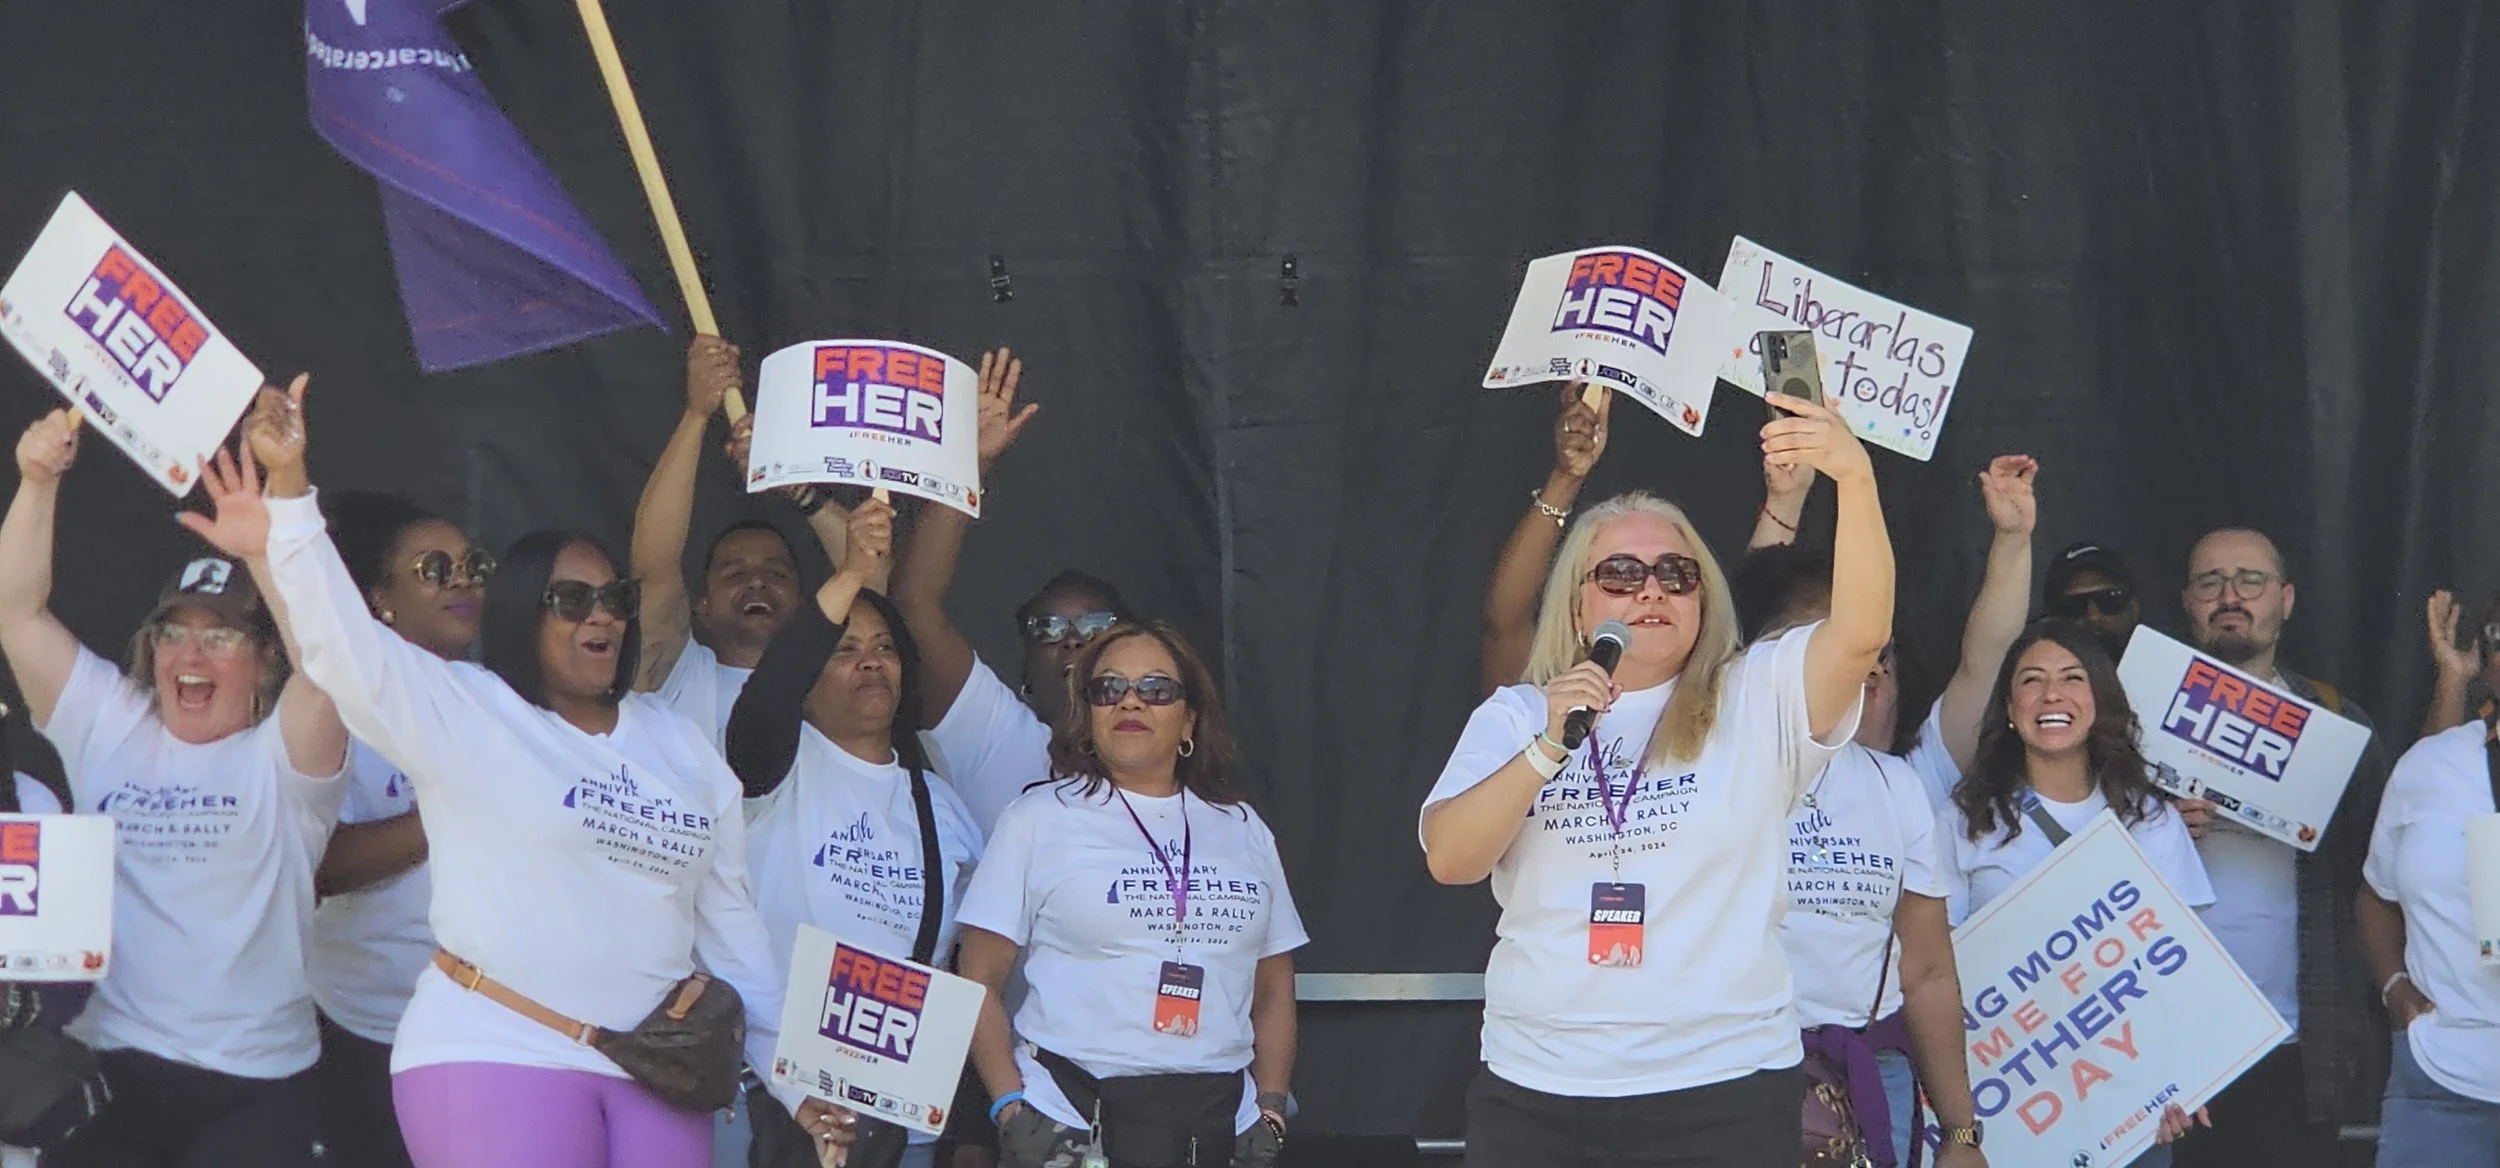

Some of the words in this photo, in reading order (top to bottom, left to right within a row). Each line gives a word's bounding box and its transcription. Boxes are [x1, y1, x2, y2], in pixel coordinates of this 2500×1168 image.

[95, 247, 210, 361] FREE
[1569, 254, 1685, 310] FREE
[69, 280, 182, 399] HER
[1554, 287, 1674, 350] HER
[1756, 261, 1946, 378] Liberarlas
[816, 348, 945, 394] FREE
[1834, 351, 1950, 440] todas!
[814, 383, 943, 438] HER
[2184, 661, 2308, 738] FREE
[2164, 691, 2293, 776] HER
[582, 787, 710, 831] FREEHER
[582, 816, 639, 841] MARCH
[662, 838, 704, 858] RALLY
[1544, 815, 1609, 831] MARCH
[1637, 801, 1690, 820] RALLY
[1661, 821, 1677, 831] DC
[1123, 878, 1259, 895] FREEHER
[1130, 907, 1186, 918] MARC
[1195, 907, 1203, 917] &
[1212, 907, 1255, 920] RALLY
[1593, 909, 1641, 923] SPEAKER
[1857, 882, 1891, 896] RALLY
[2007, 880, 2141, 993] MOMS
[2060, 908, 2164, 996] FOR
[832, 947, 930, 1008] FREE
[821, 986, 917, 1056] HER
[2016, 1020, 2140, 1136] DAY
